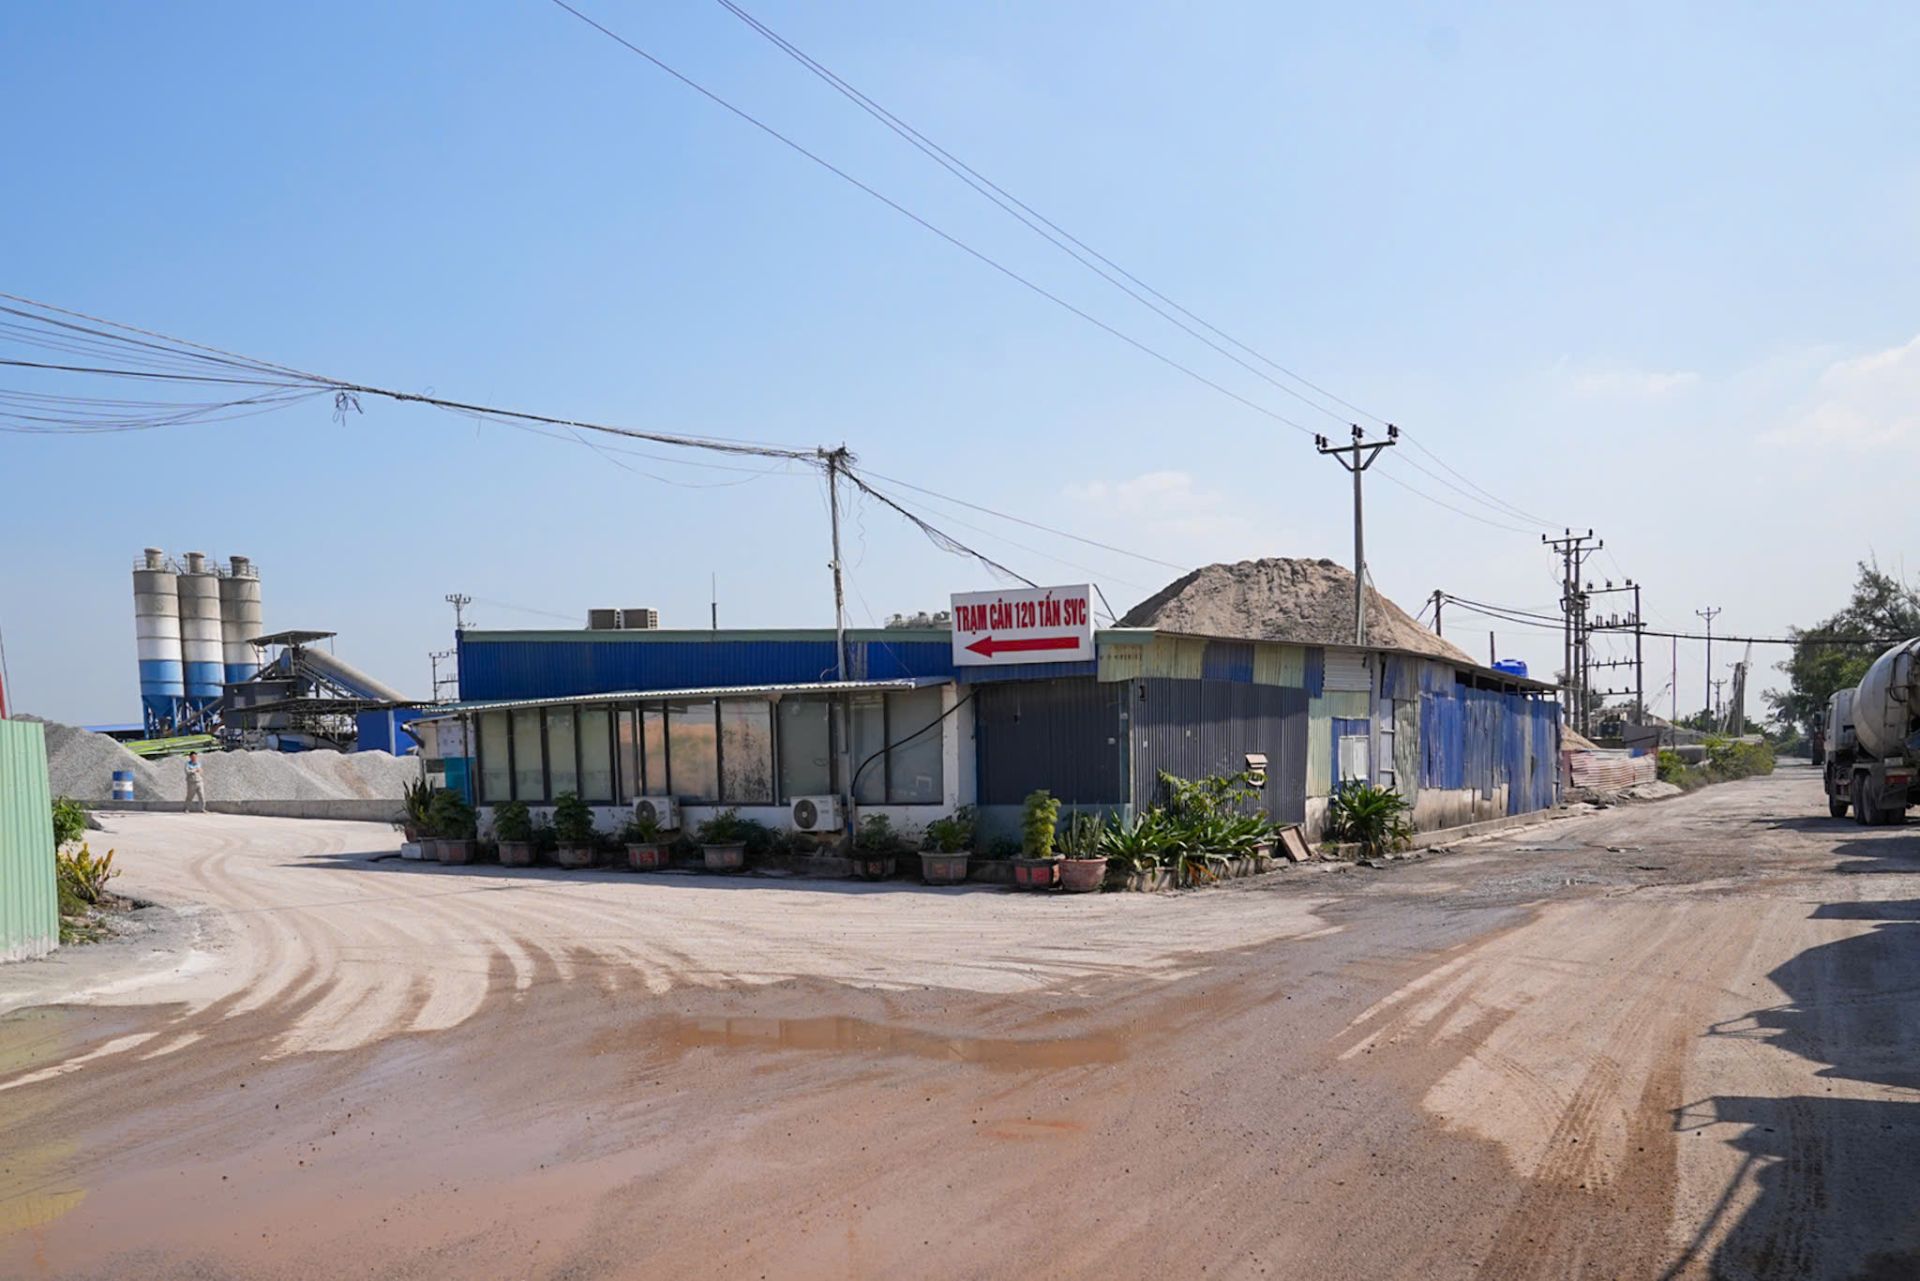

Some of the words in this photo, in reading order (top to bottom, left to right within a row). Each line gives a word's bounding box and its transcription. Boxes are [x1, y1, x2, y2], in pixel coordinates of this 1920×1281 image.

[955, 604, 987, 635] TRẠM
[990, 597, 1012, 630] CÂN
[1015, 601, 1036, 628] 120
[1038, 590, 1060, 627] TẤN
